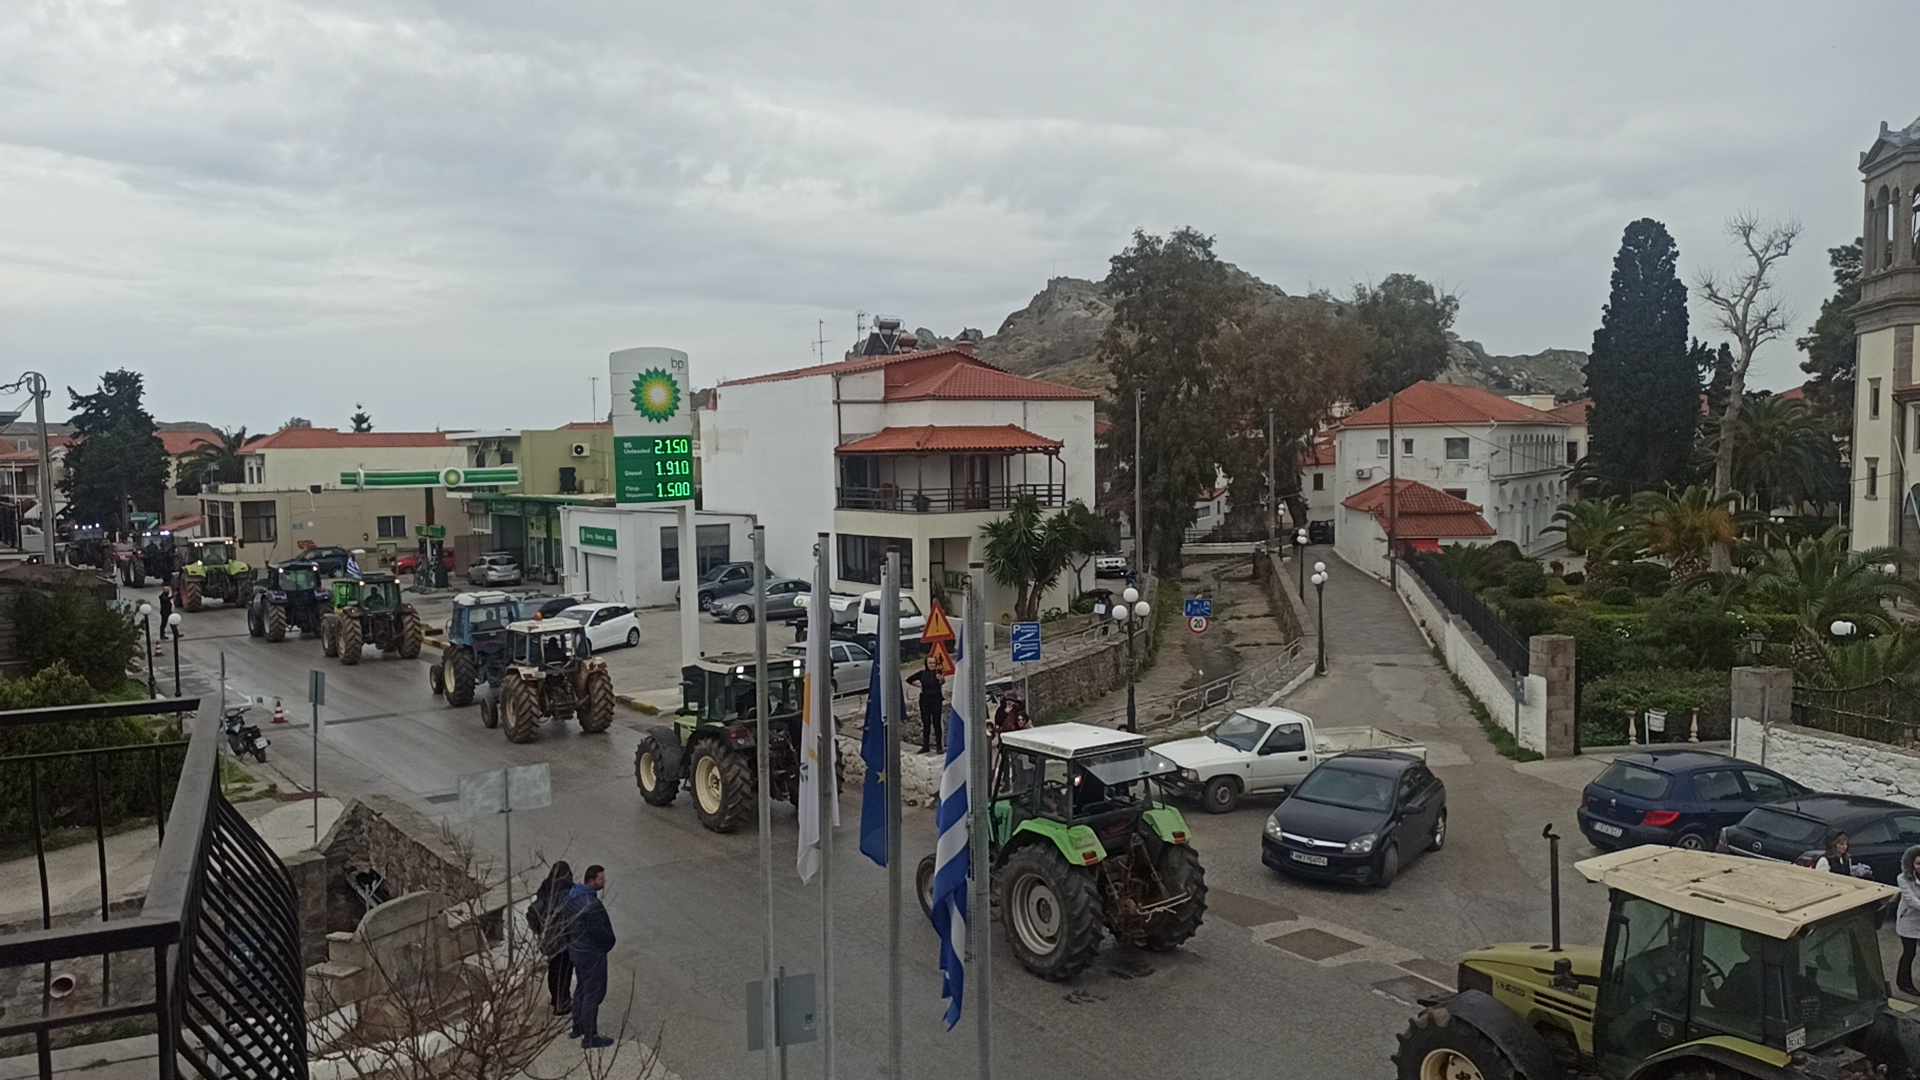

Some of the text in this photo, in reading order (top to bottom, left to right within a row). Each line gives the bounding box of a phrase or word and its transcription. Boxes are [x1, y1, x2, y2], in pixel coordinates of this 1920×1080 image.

[671, 356, 684, 371] bp
[654, 439, 688, 454] 2.150
[655, 460, 689, 475] 1.910
[656, 482, 690, 497] 1.500
[1013, 624, 1021, 634] P
[1194, 618, 1204, 628] 20
[1013, 643, 1022, 653] P
